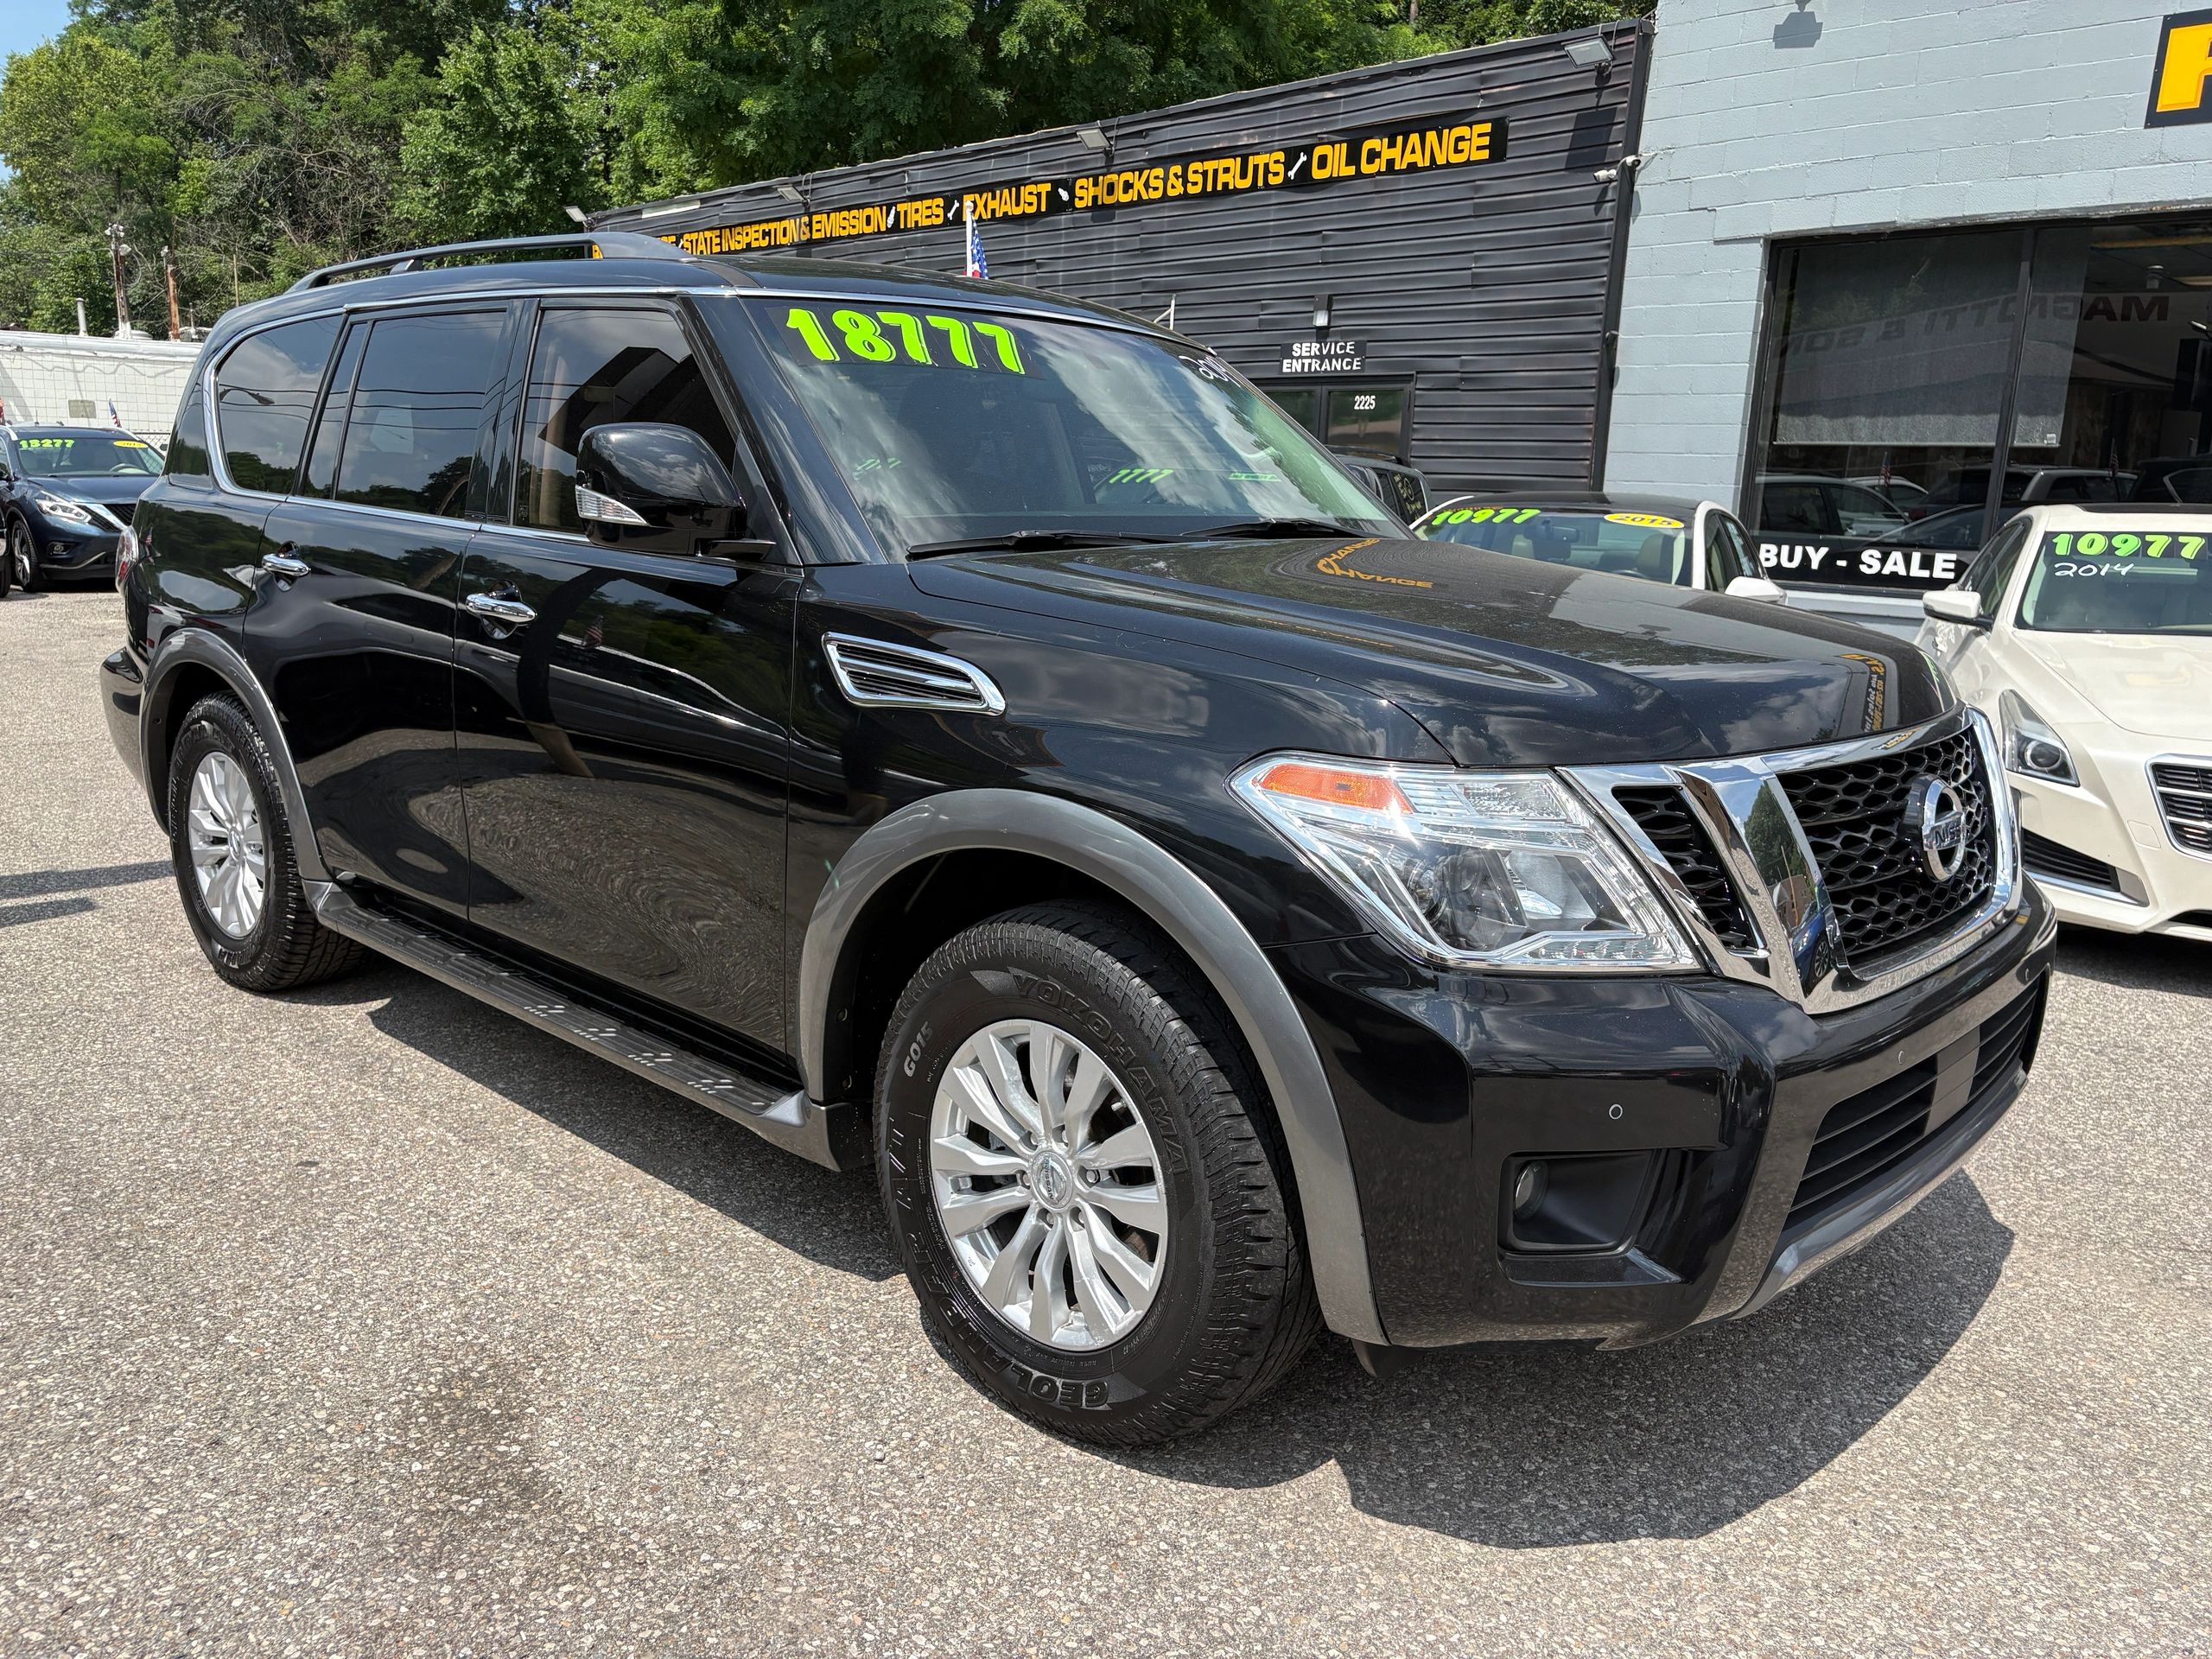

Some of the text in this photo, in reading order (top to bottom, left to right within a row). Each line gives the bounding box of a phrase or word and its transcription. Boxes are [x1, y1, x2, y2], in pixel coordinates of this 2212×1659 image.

[1312, 122, 1492, 180] OIL CHANGE
[1074, 151, 1286, 208] SHOCKS & STRUTS
[897, 197, 944, 228] TIRES
[963, 182, 1052, 222] EXHAUST
[683, 230, 720, 256] STATE
[722, 218, 799, 251] INSPECTION
[801, 216, 810, 240] &
[812, 206, 886, 239] EMISSION
[786, 308, 1026, 375] 18777
[1292, 341, 1356, 357] SERVICE
[1282, 358, 1362, 373] ENTRANCE
[1353, 395, 1376, 410] 2225
[1431, 508, 1541, 526] 10977
[1759, 543, 1829, 569] BUY
[1859, 549, 1957, 579] SALE
[2052, 532, 2206, 560] 10977
[2054, 563, 2135, 577] 2014
[1013, 973, 1189, 1173] YOKOHAMA
